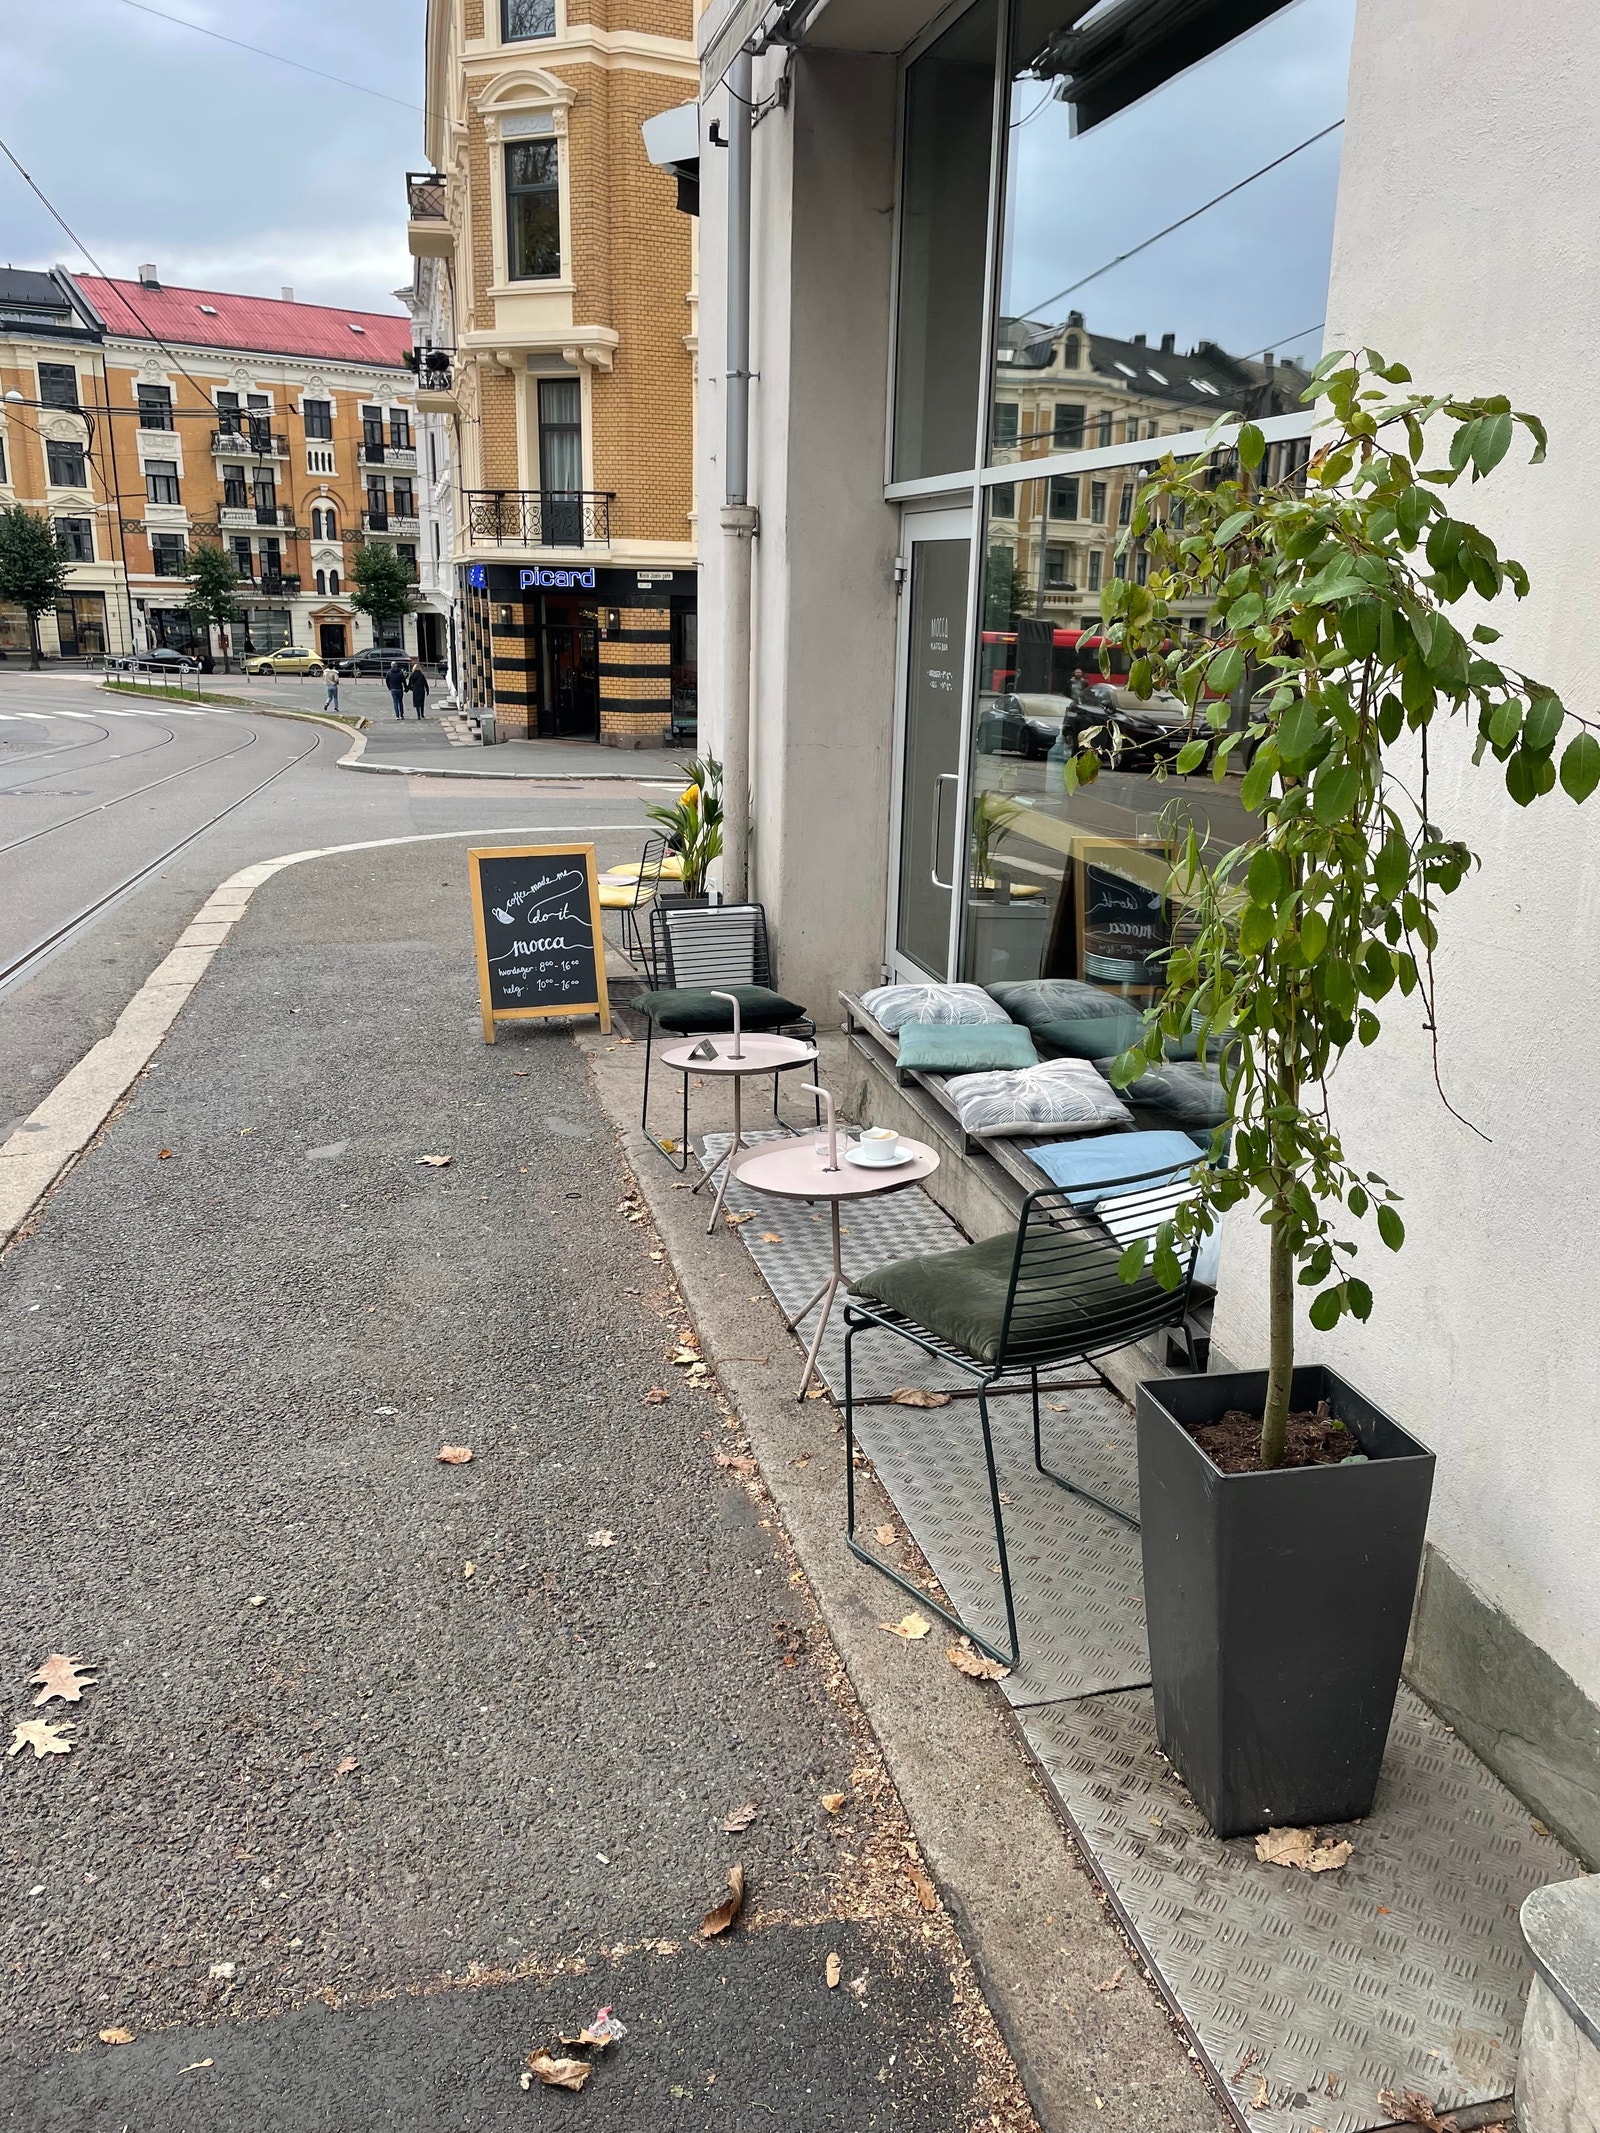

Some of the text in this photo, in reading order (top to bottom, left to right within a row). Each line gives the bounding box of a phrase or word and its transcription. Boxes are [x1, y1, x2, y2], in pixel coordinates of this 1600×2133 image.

[519, 566, 596, 590] picard
[930, 617, 948, 638] MOCCA
[506, 869, 569, 907] coffee made me
[533, 902, 570, 923] do it
[512, 936, 564, 957] mocca
